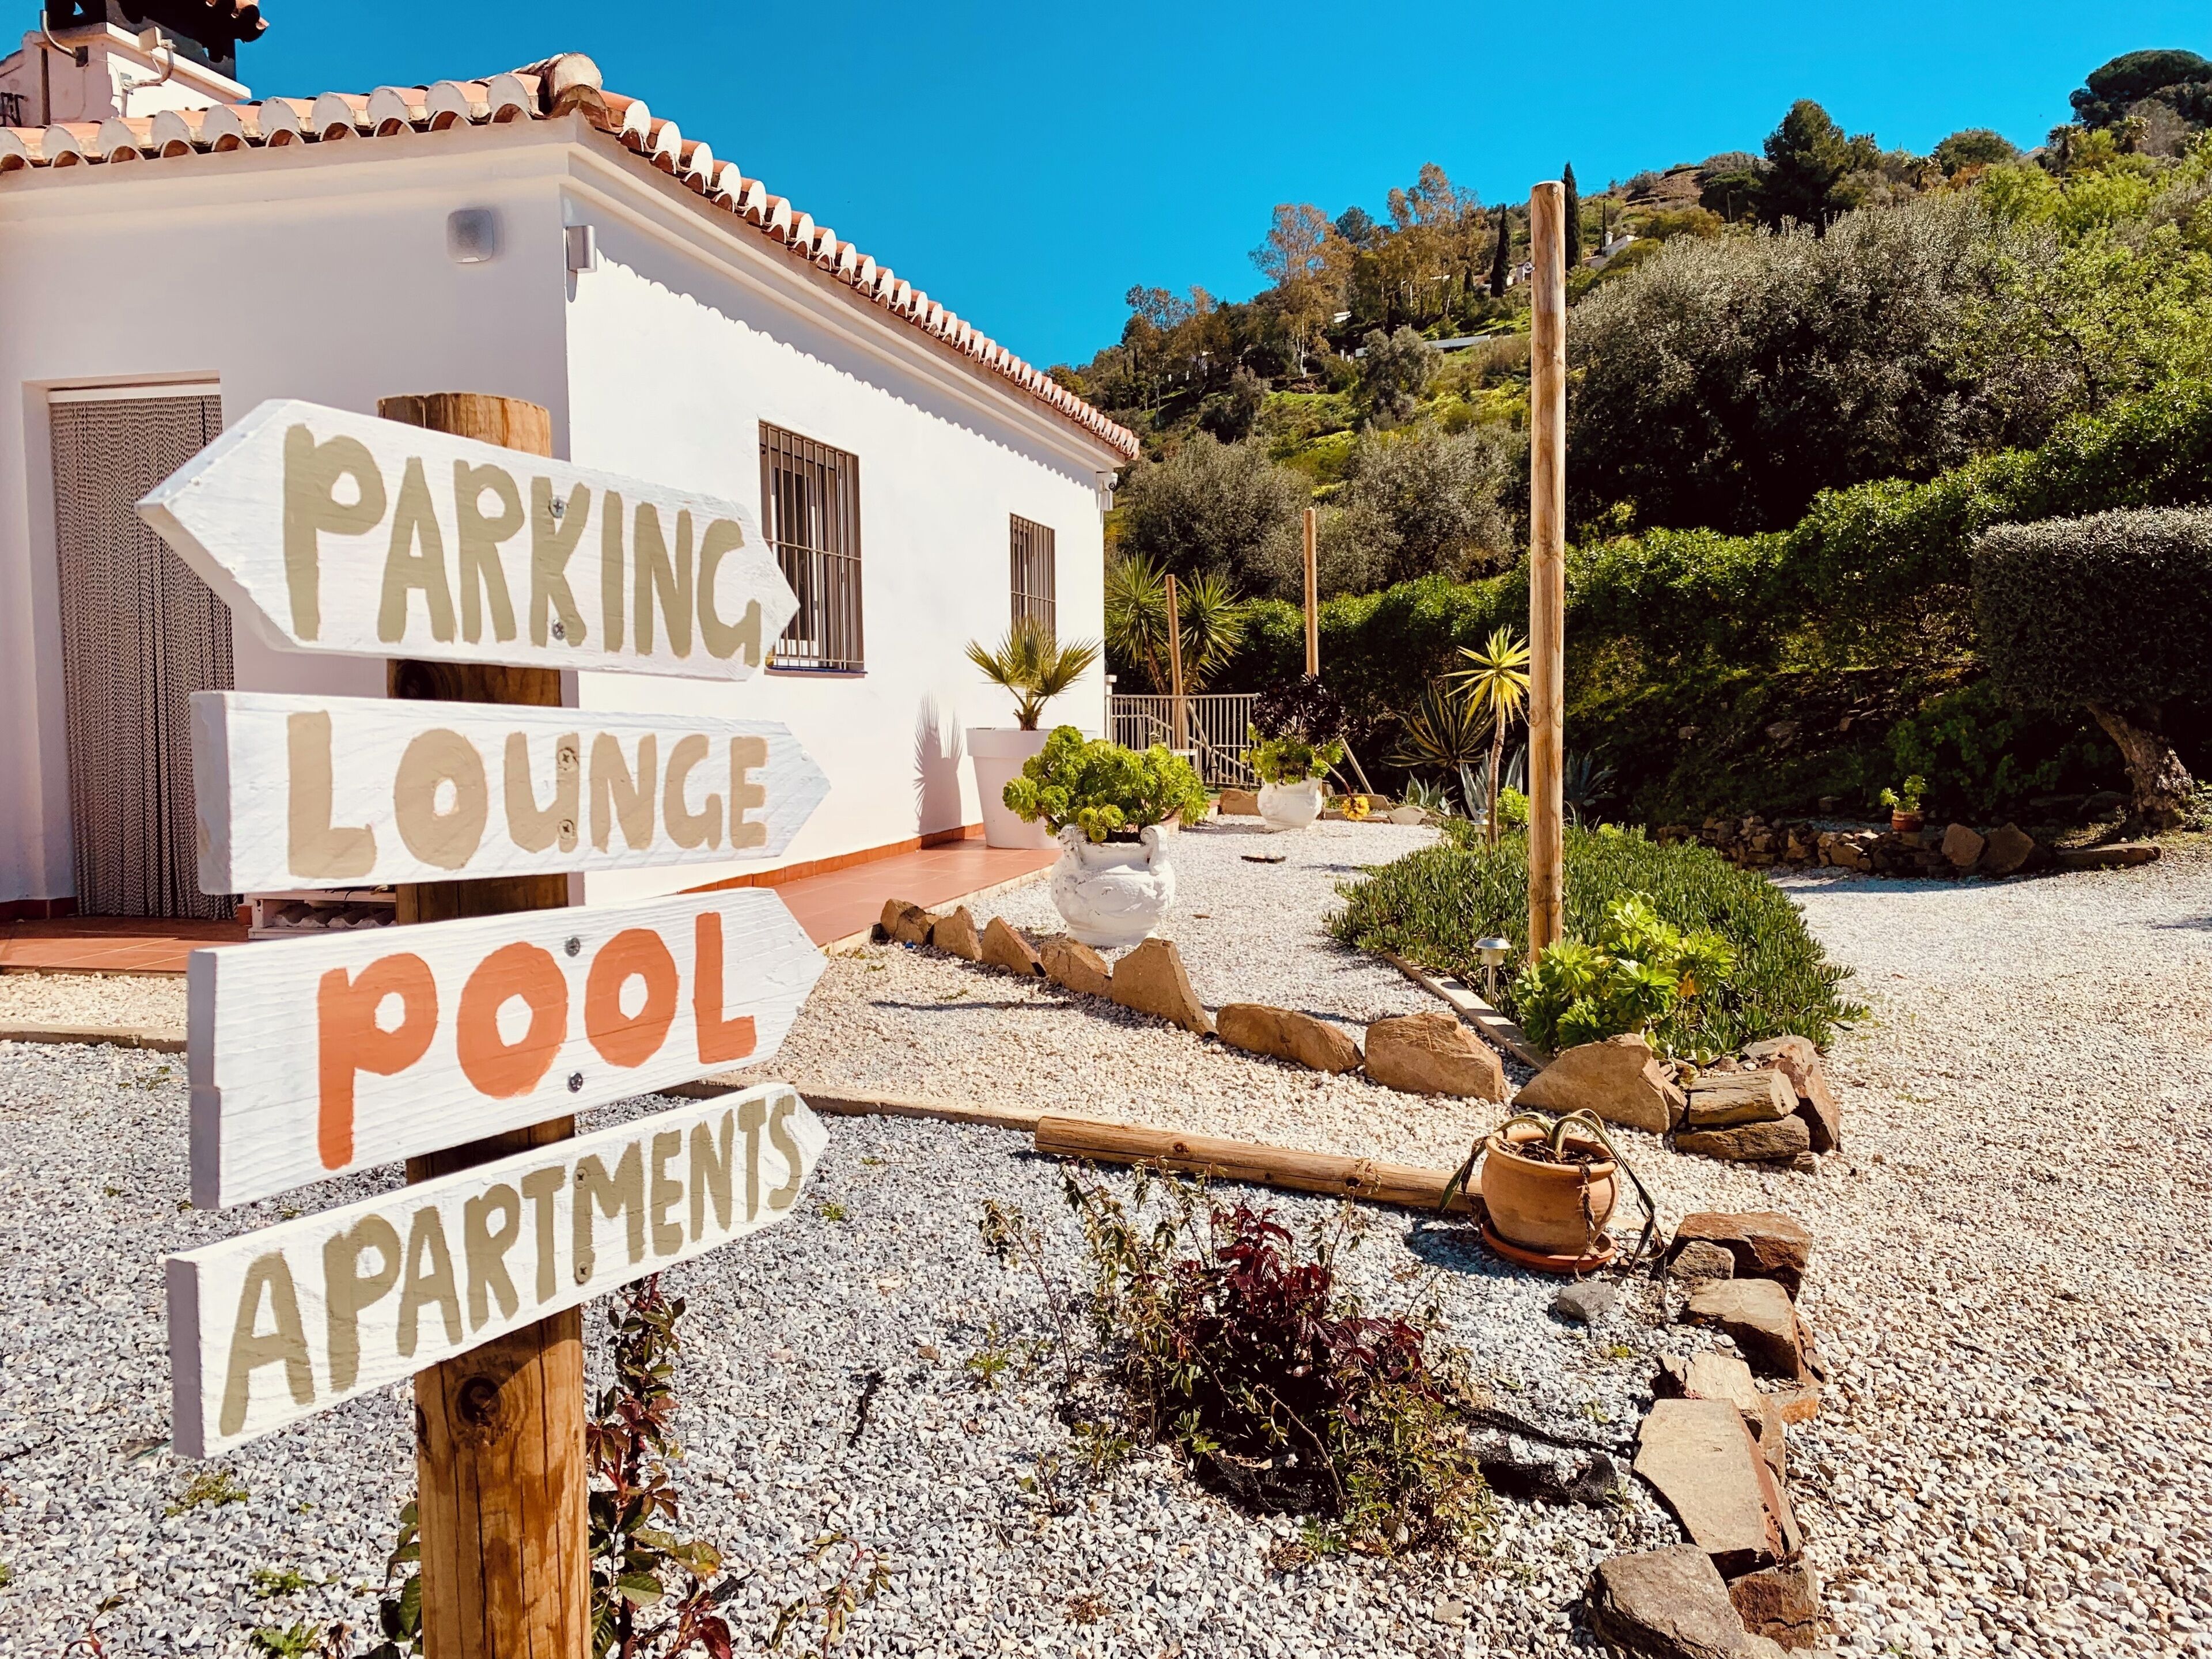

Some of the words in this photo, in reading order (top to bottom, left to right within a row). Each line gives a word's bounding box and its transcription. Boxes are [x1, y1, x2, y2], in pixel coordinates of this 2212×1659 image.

[283, 423, 762, 667] PARKING
[287, 710, 768, 879] LOUNGE
[317, 912, 757, 1171] POOL
[219, 1094, 803, 1436] APARTMENTS
